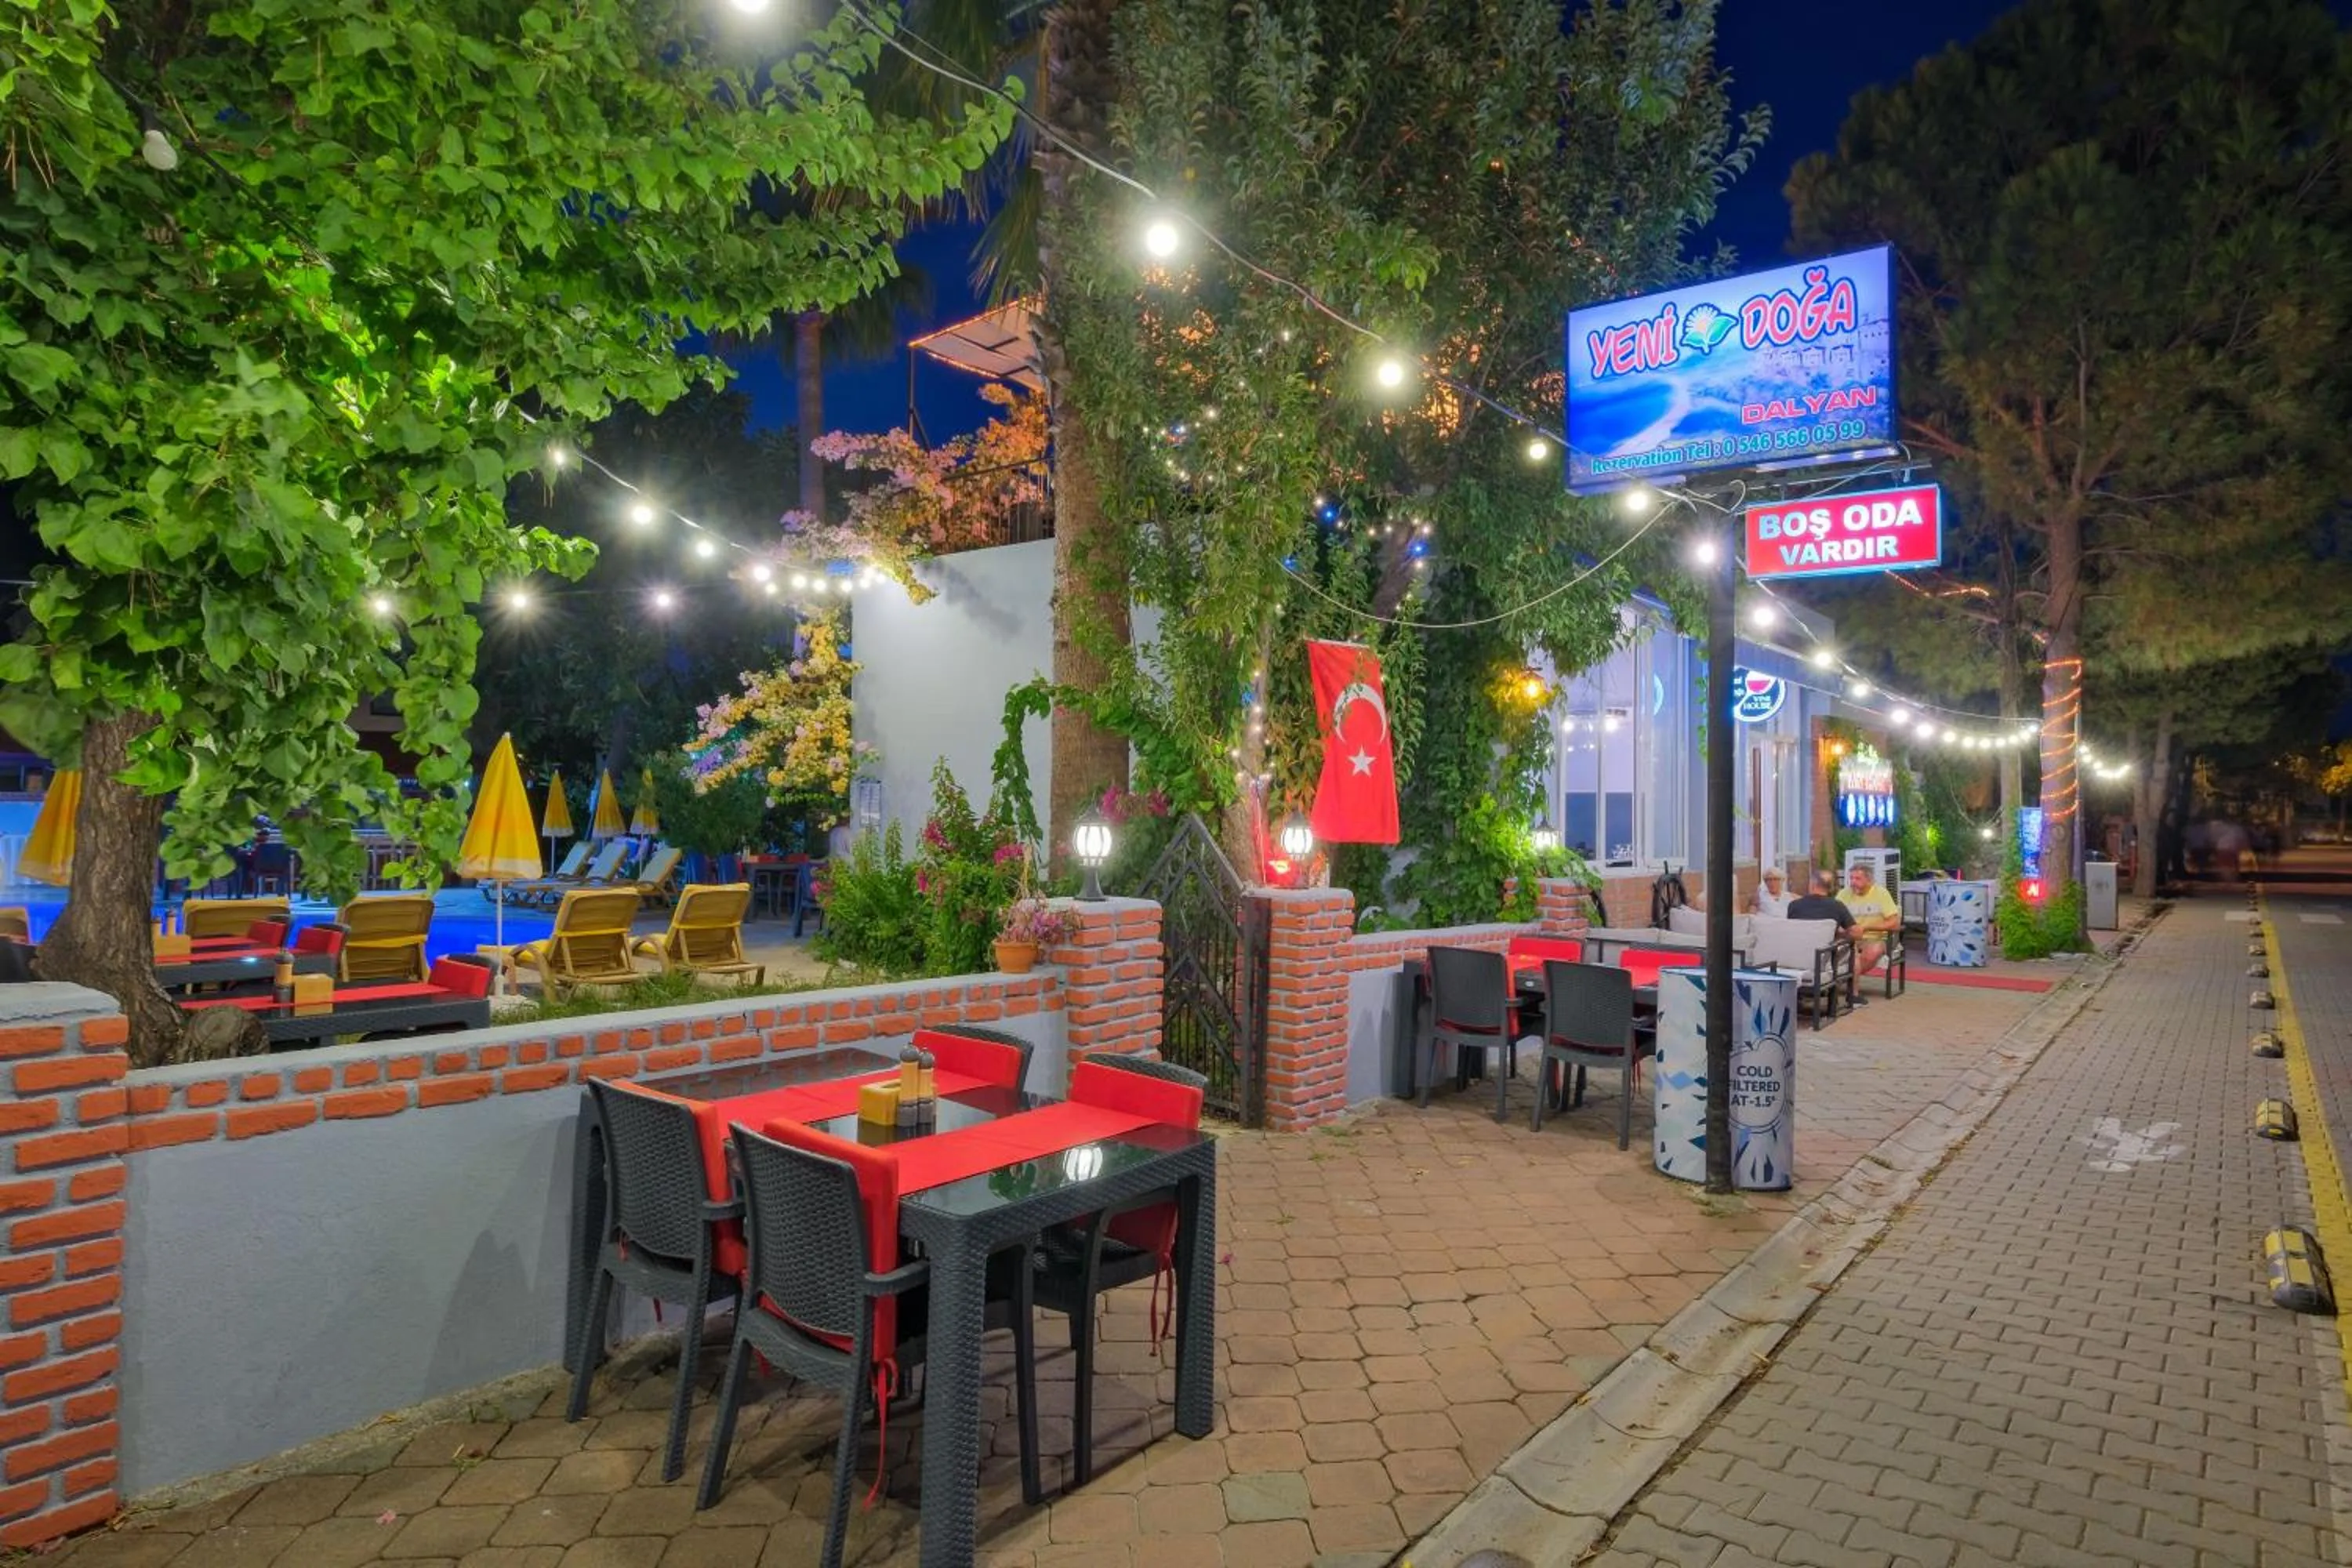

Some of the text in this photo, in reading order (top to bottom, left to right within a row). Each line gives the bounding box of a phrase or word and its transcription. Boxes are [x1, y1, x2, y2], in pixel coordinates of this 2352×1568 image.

[1589, 267, 1855, 378] YENİ DOĞA
[1742, 386, 1875, 424] DALYAN
[1738, 432, 1772, 453] 546
[1774, 426, 1810, 449] 566
[1813, 423, 1836, 444] 05
[1840, 419, 1865, 439] 99
[1759, 499, 1923, 540] BOŞ ODA
[1779, 535, 1899, 565] VARDIR
[1737, 1065, 1773, 1078] COLD
